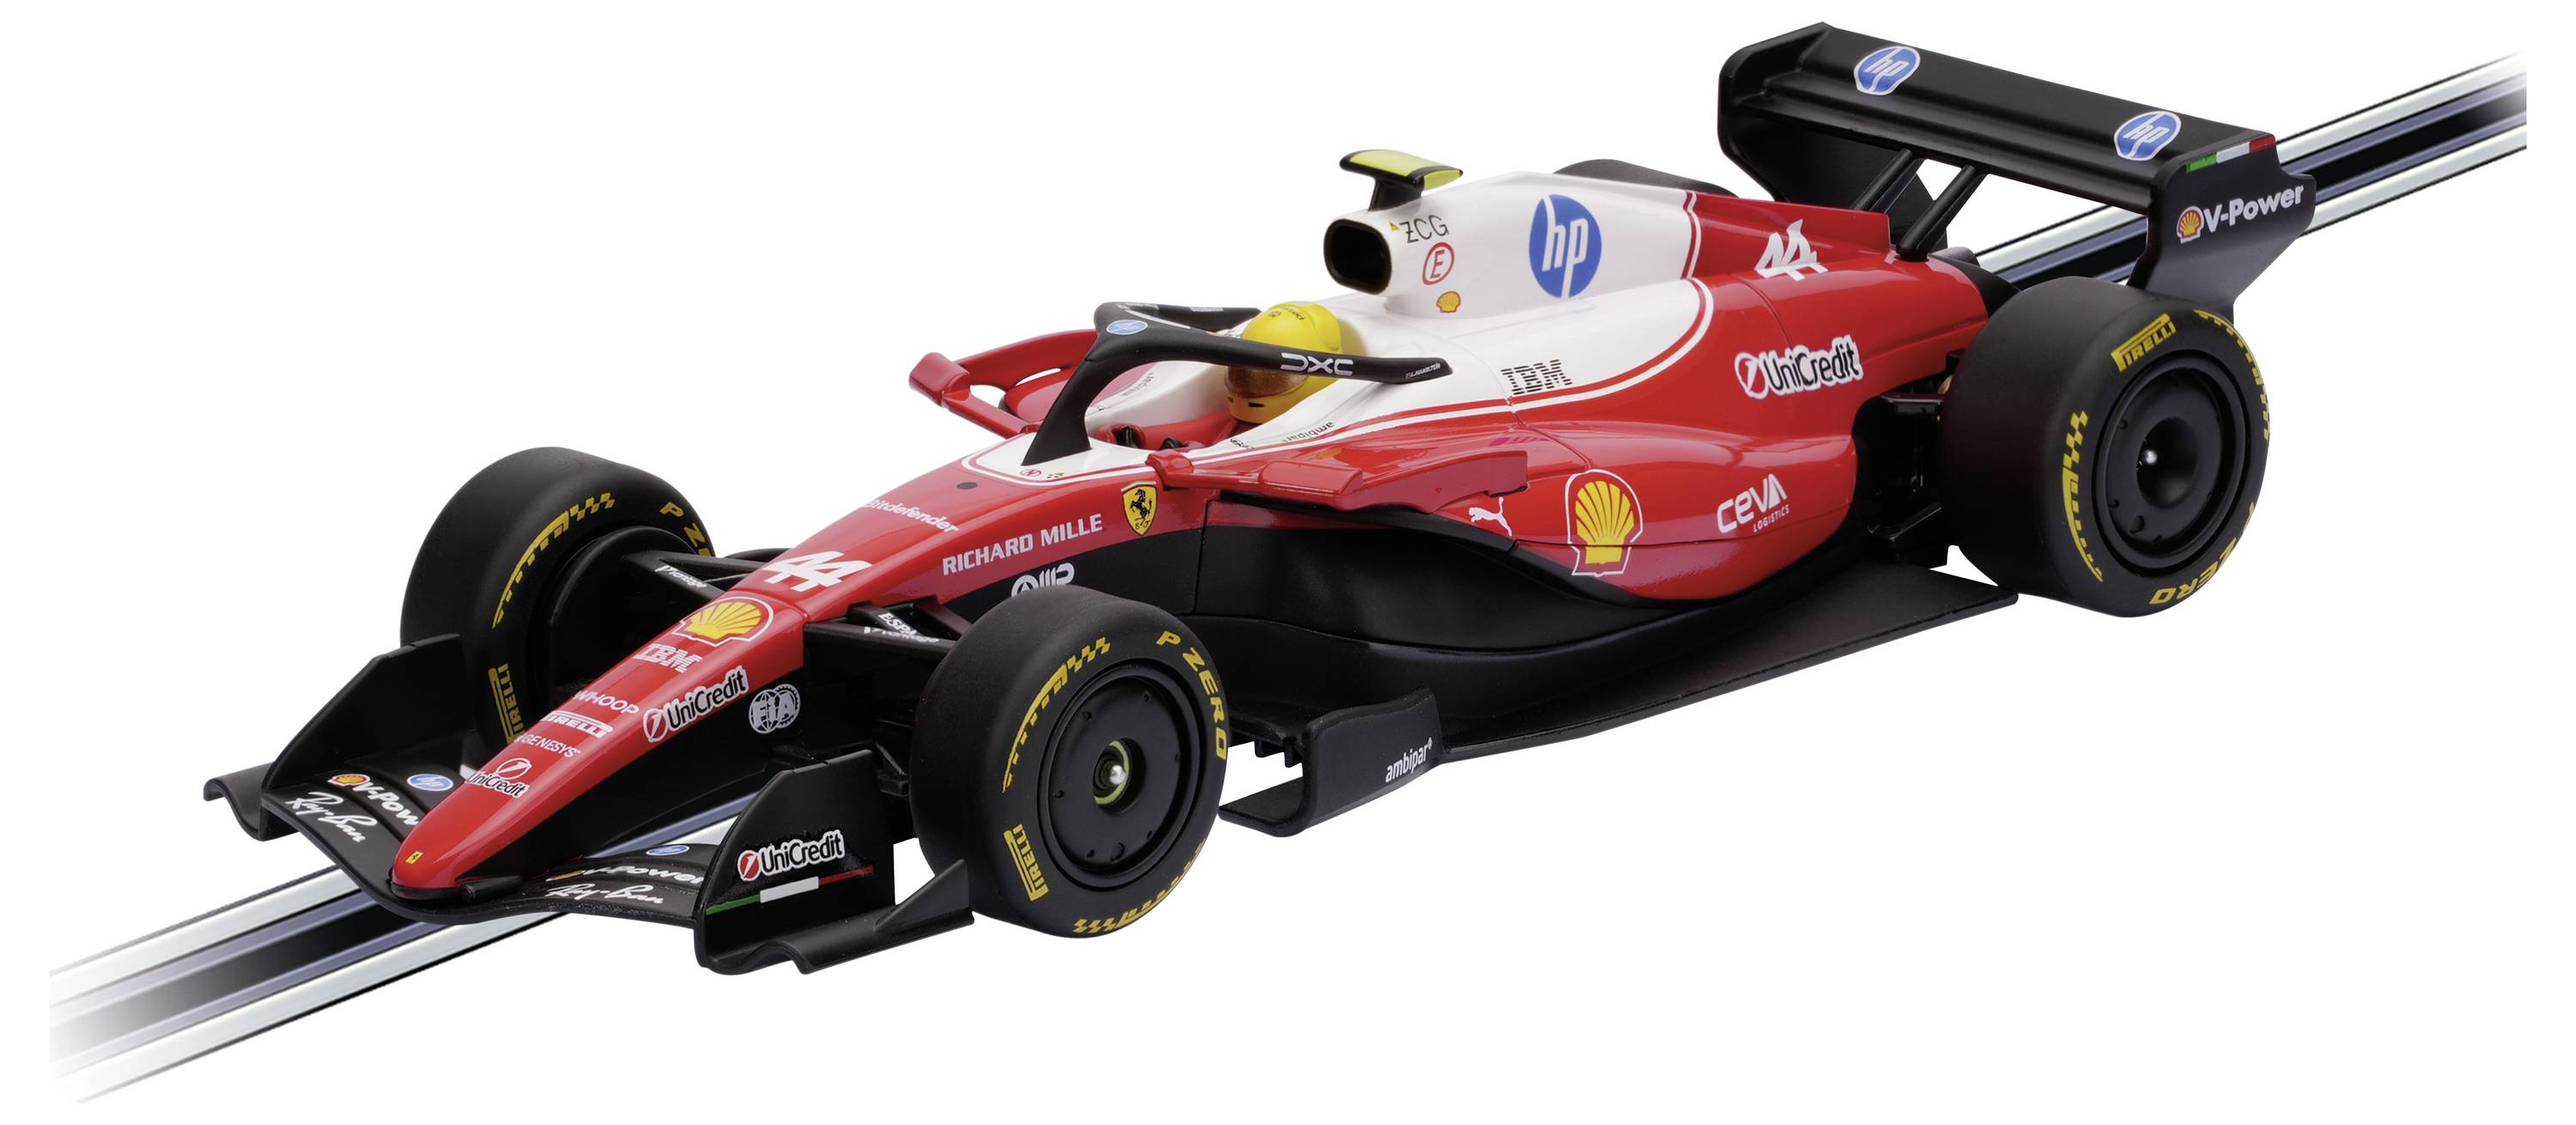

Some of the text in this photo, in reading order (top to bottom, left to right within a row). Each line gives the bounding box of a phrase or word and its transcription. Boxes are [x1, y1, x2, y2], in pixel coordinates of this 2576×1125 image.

[1862, 46, 1911, 93] hp
[2120, 111, 2172, 158] hp
[1399, 215, 1449, 243] ZCG
[2203, 185, 2304, 233] V-Power
[1540, 194, 1589, 299] hp
[2111, 313, 2177, 372] PIRELLI
[1280, 352, 1354, 377] DXC
[1501, 359, 1572, 396] IBM
[1763, 342, 1859, 391] UniCredit
[659, 502, 684, 517] P
[1753, 504, 1790, 532] LOGISTICS
[942, 514, 1104, 575] RICHARD MILLE
[763, 550, 872, 593] 44
[633, 643, 703, 673] IBM
[488, 663, 526, 744] PIRELLI
[573, 689, 640, 714] WHOOP
[667, 670, 746, 729] UniCredit
[751, 688, 799, 730] FIA
[1156, 629, 1229, 761] P ZERO
[521, 734, 578, 757] GENESYS
[539, 709, 613, 739] PIRELLI
[1385, 738, 1432, 783] ambipar
[467, 771, 527, 798] UniCredit
[285, 791, 378, 842] Ray-Ban
[761, 833, 841, 873] UniCredit
[1003, 824, 1049, 902] PIRELLI
[544, 883, 665, 904] Ray-Ban
